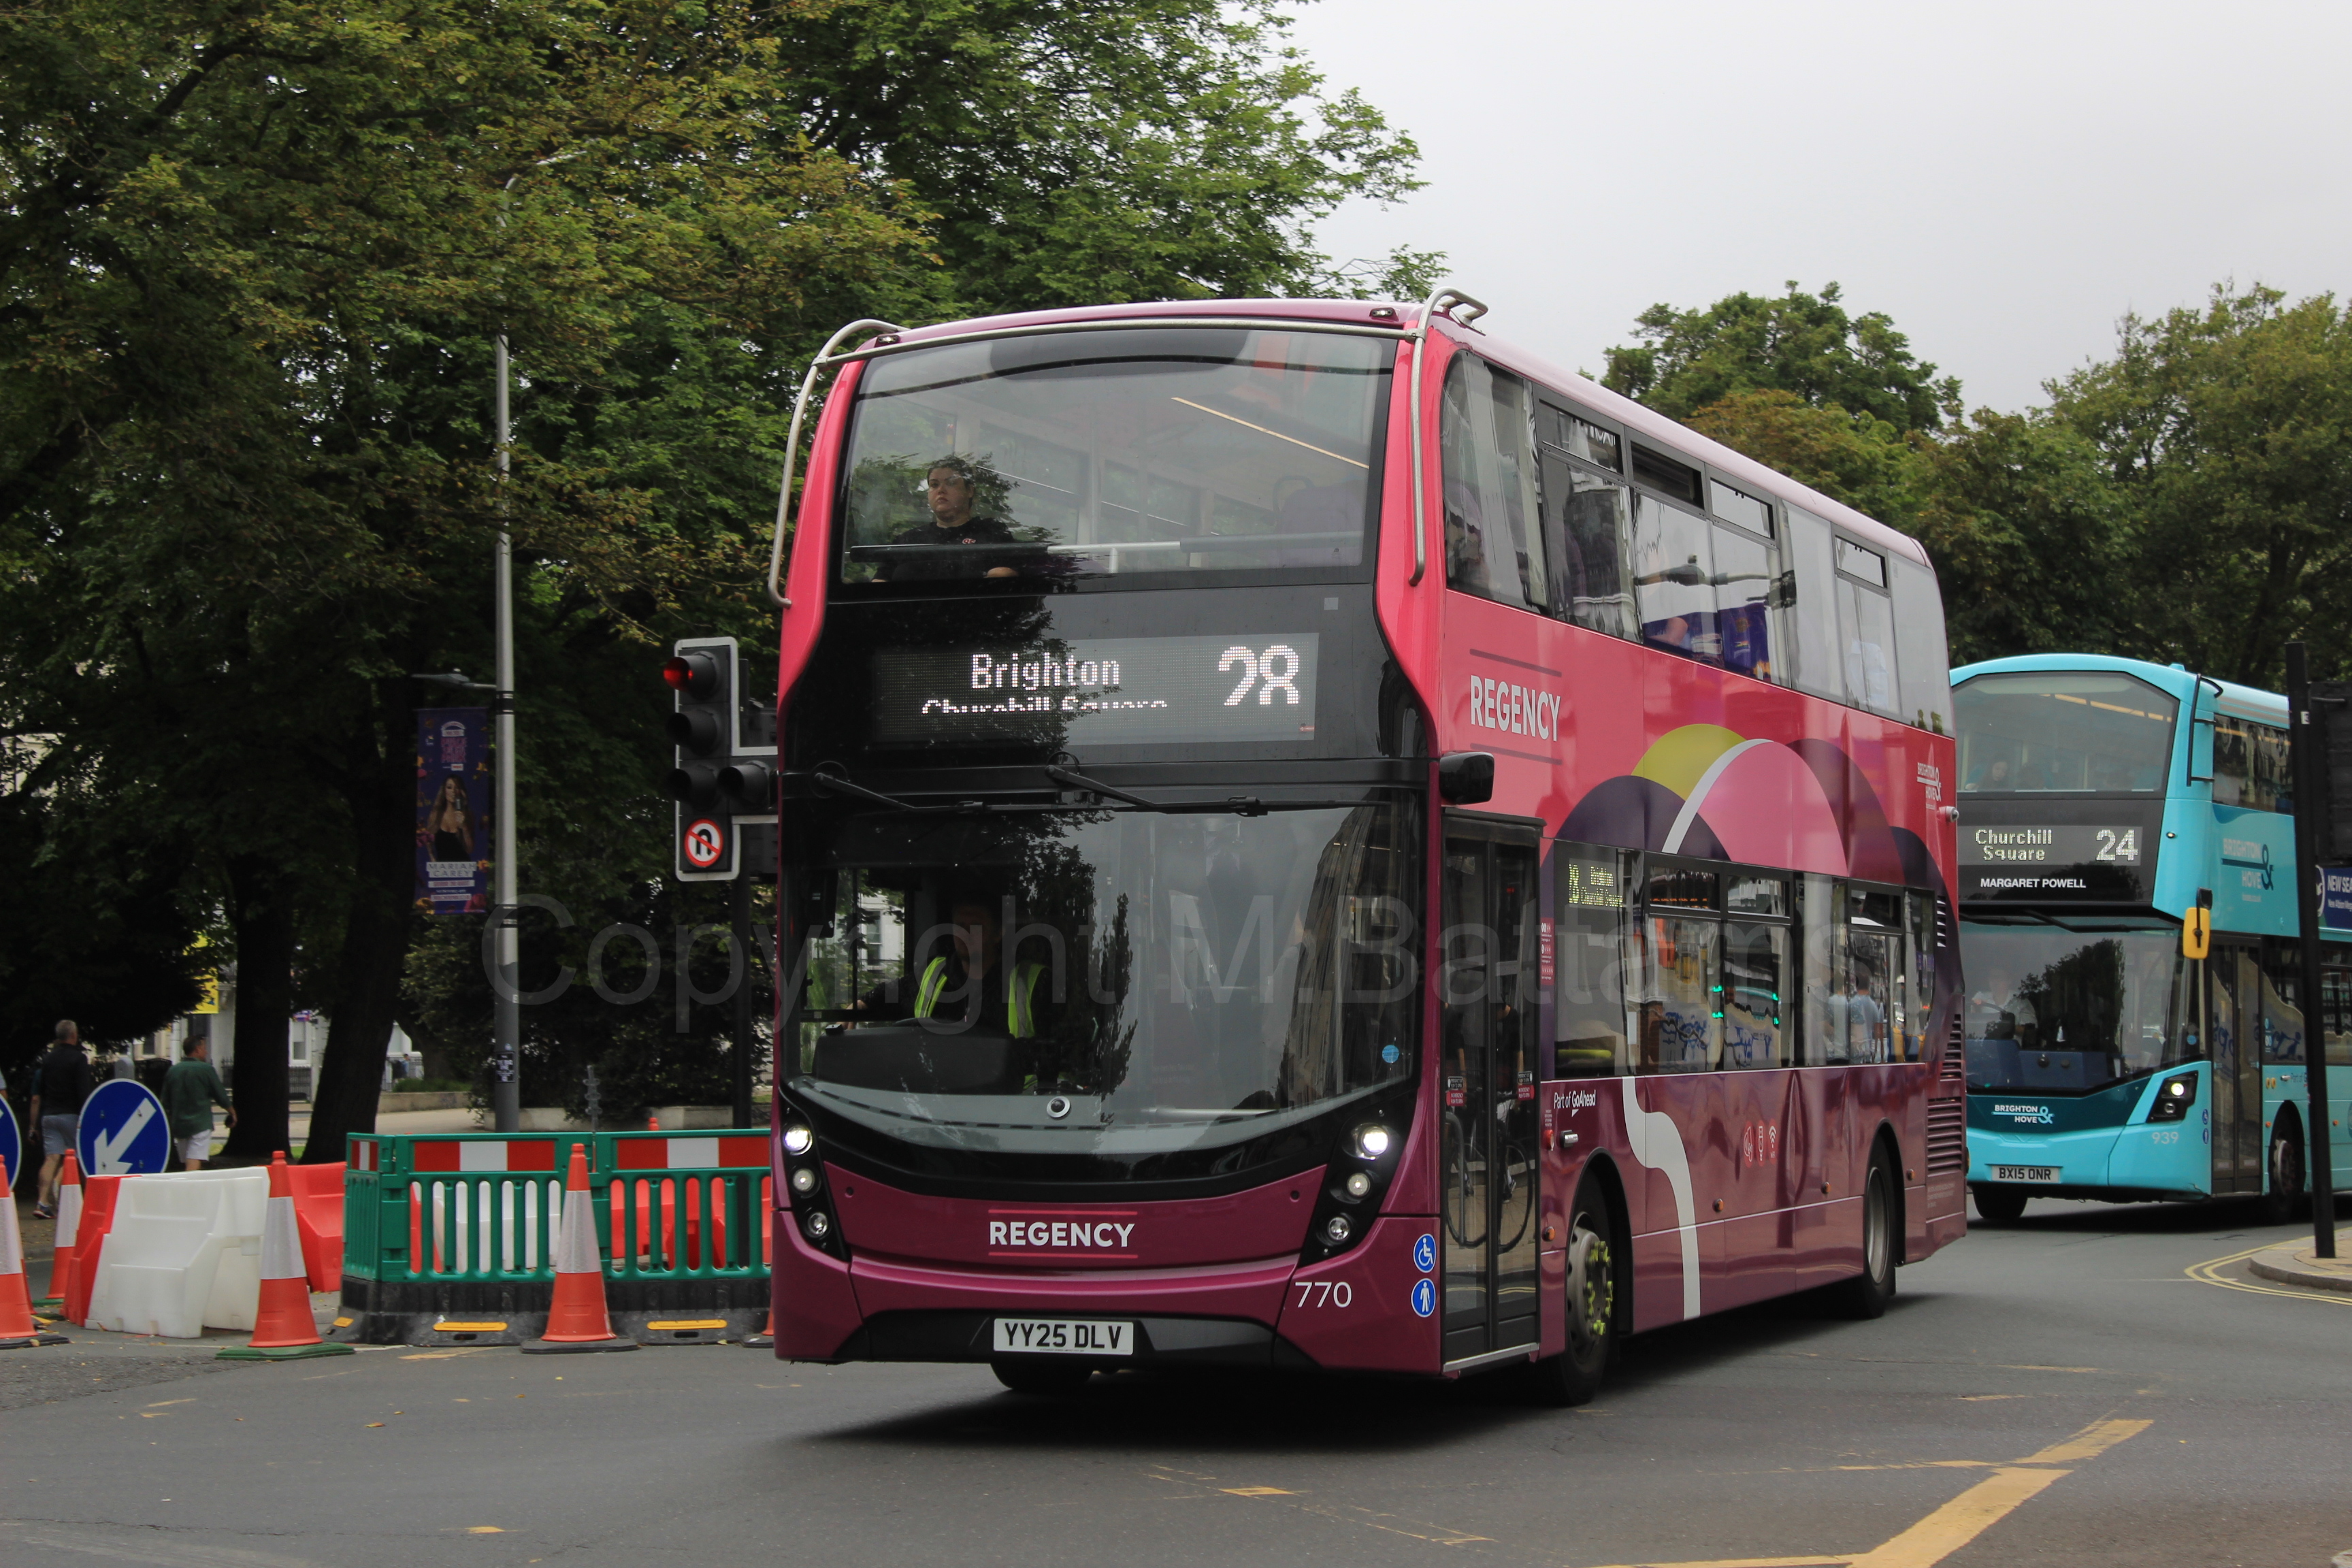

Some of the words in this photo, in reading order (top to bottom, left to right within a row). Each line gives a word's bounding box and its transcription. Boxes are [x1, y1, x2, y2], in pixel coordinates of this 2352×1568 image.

[972, 652, 1120, 691] Brighton
[1218, 645, 1298, 706] 28
[1471, 674, 1561, 742] REGENCY
[1975, 829, 2052, 845] Churchill
[2095, 829, 2138, 862] 24
[1982, 845, 2046, 862] Square
[2223, 838, 2261, 859] BRIGHTON
[429, 862, 476, 870] MARIAH
[1980, 878, 2040, 888] MARGARET
[2042, 879, 2086, 889] POWELL
[2241, 870, 2262, 889] HOVE
[2328, 875, 2342, 892] NEW
[1554, 1092, 1564, 1109] Part
[1565, 1091, 1571, 1108] of
[1572, 1090, 1596, 1108] GoAhead
[1995, 1105, 2038, 1113] BRIGHTON
[2014, 1115, 2038, 1124] HOVE
[2151, 1132, 2178, 1145] 939
[1999, 1167, 2025, 1179] BX15
[2028, 1168, 2051, 1181] ONR
[990, 1221, 1135, 1247] REGENCY
[1295, 1281, 1352, 1308] 770
[1004, 1322, 1066, 1348] YY25
[1075, 1324, 1122, 1349] DLV
